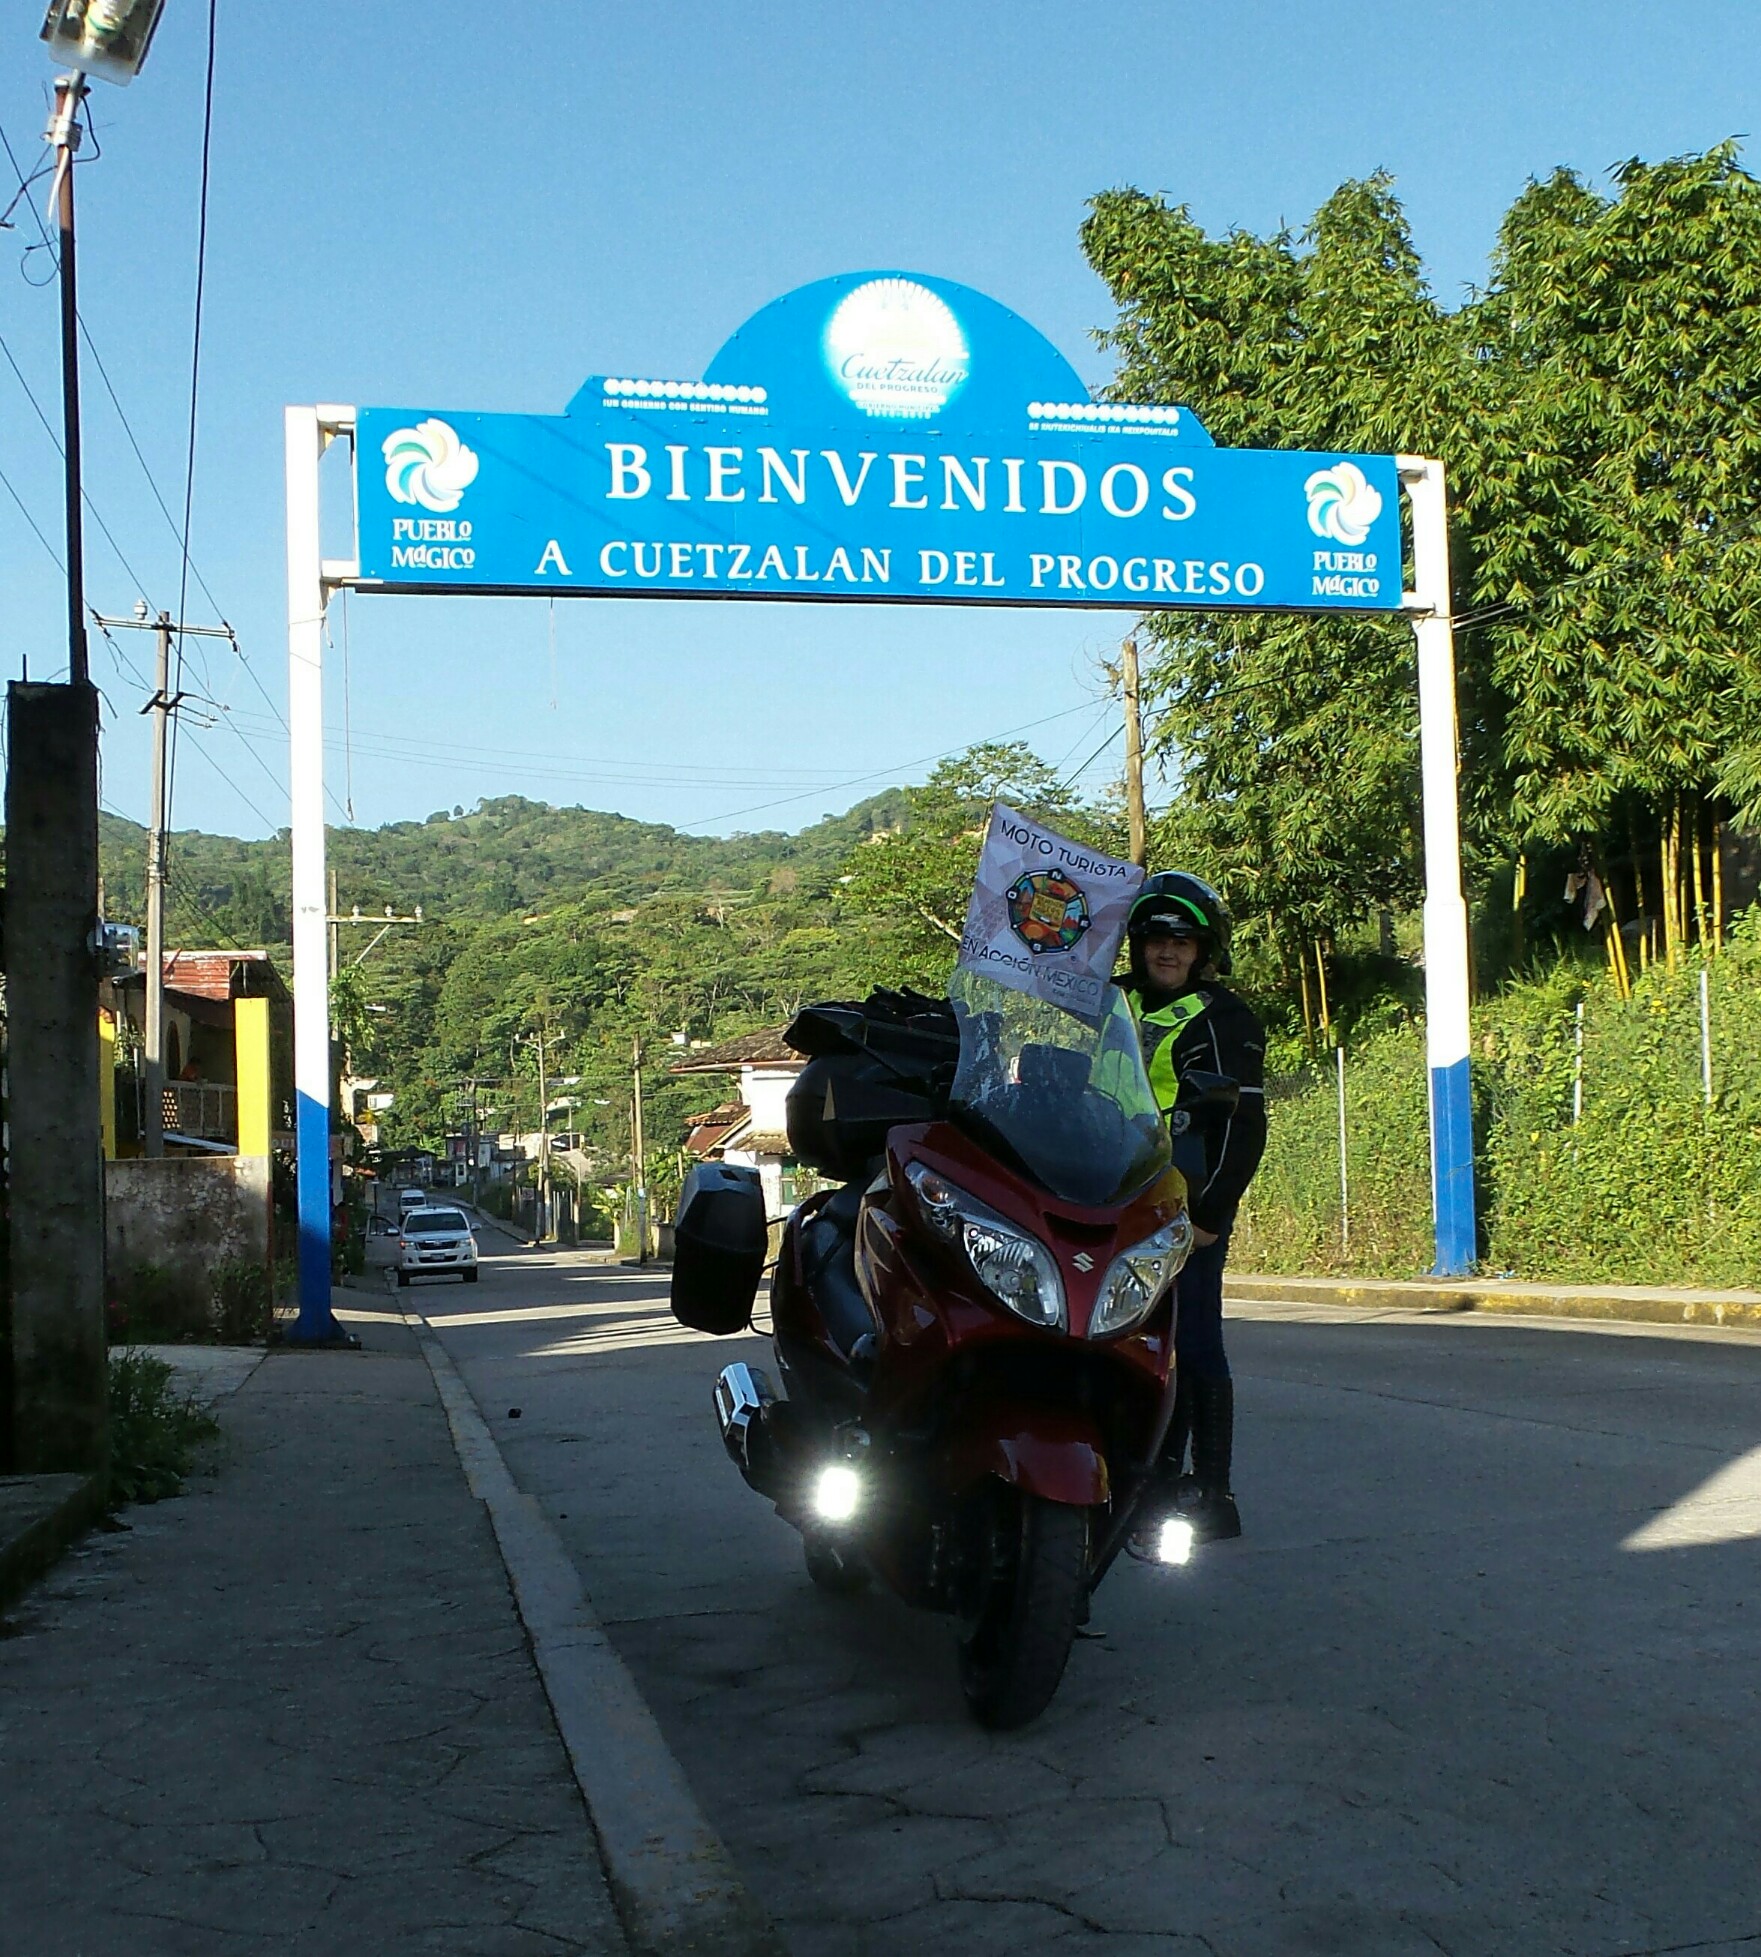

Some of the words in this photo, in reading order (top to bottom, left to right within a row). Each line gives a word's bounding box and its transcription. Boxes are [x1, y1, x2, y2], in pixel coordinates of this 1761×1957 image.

[841, 353, 968, 385] Cuetzalan
[857, 382, 876, 390] DEL
[879, 383, 938, 393] PROGRESO
[621, 399, 667, 410] GOBIERNO
[668, 401, 688, 411] CON
[689, 402, 727, 413] SENTIDO
[604, 443, 1196, 521] BIENVENIDOS
[534, 539, 572, 576] A
[599, 541, 892, 583] CUETZALAN
[918, 550, 1005, 587] DEL
[1029, 554, 1265, 596] PROGRESO
[1001, 819, 1054, 855] MOTO
[1058, 847, 1126, 877] TURISTA
[1051, 871, 1062, 880] N
[1007, 890, 1018, 899] O
[962, 935, 979, 954] EN
[979, 945, 1040, 977] ACCIÓN
